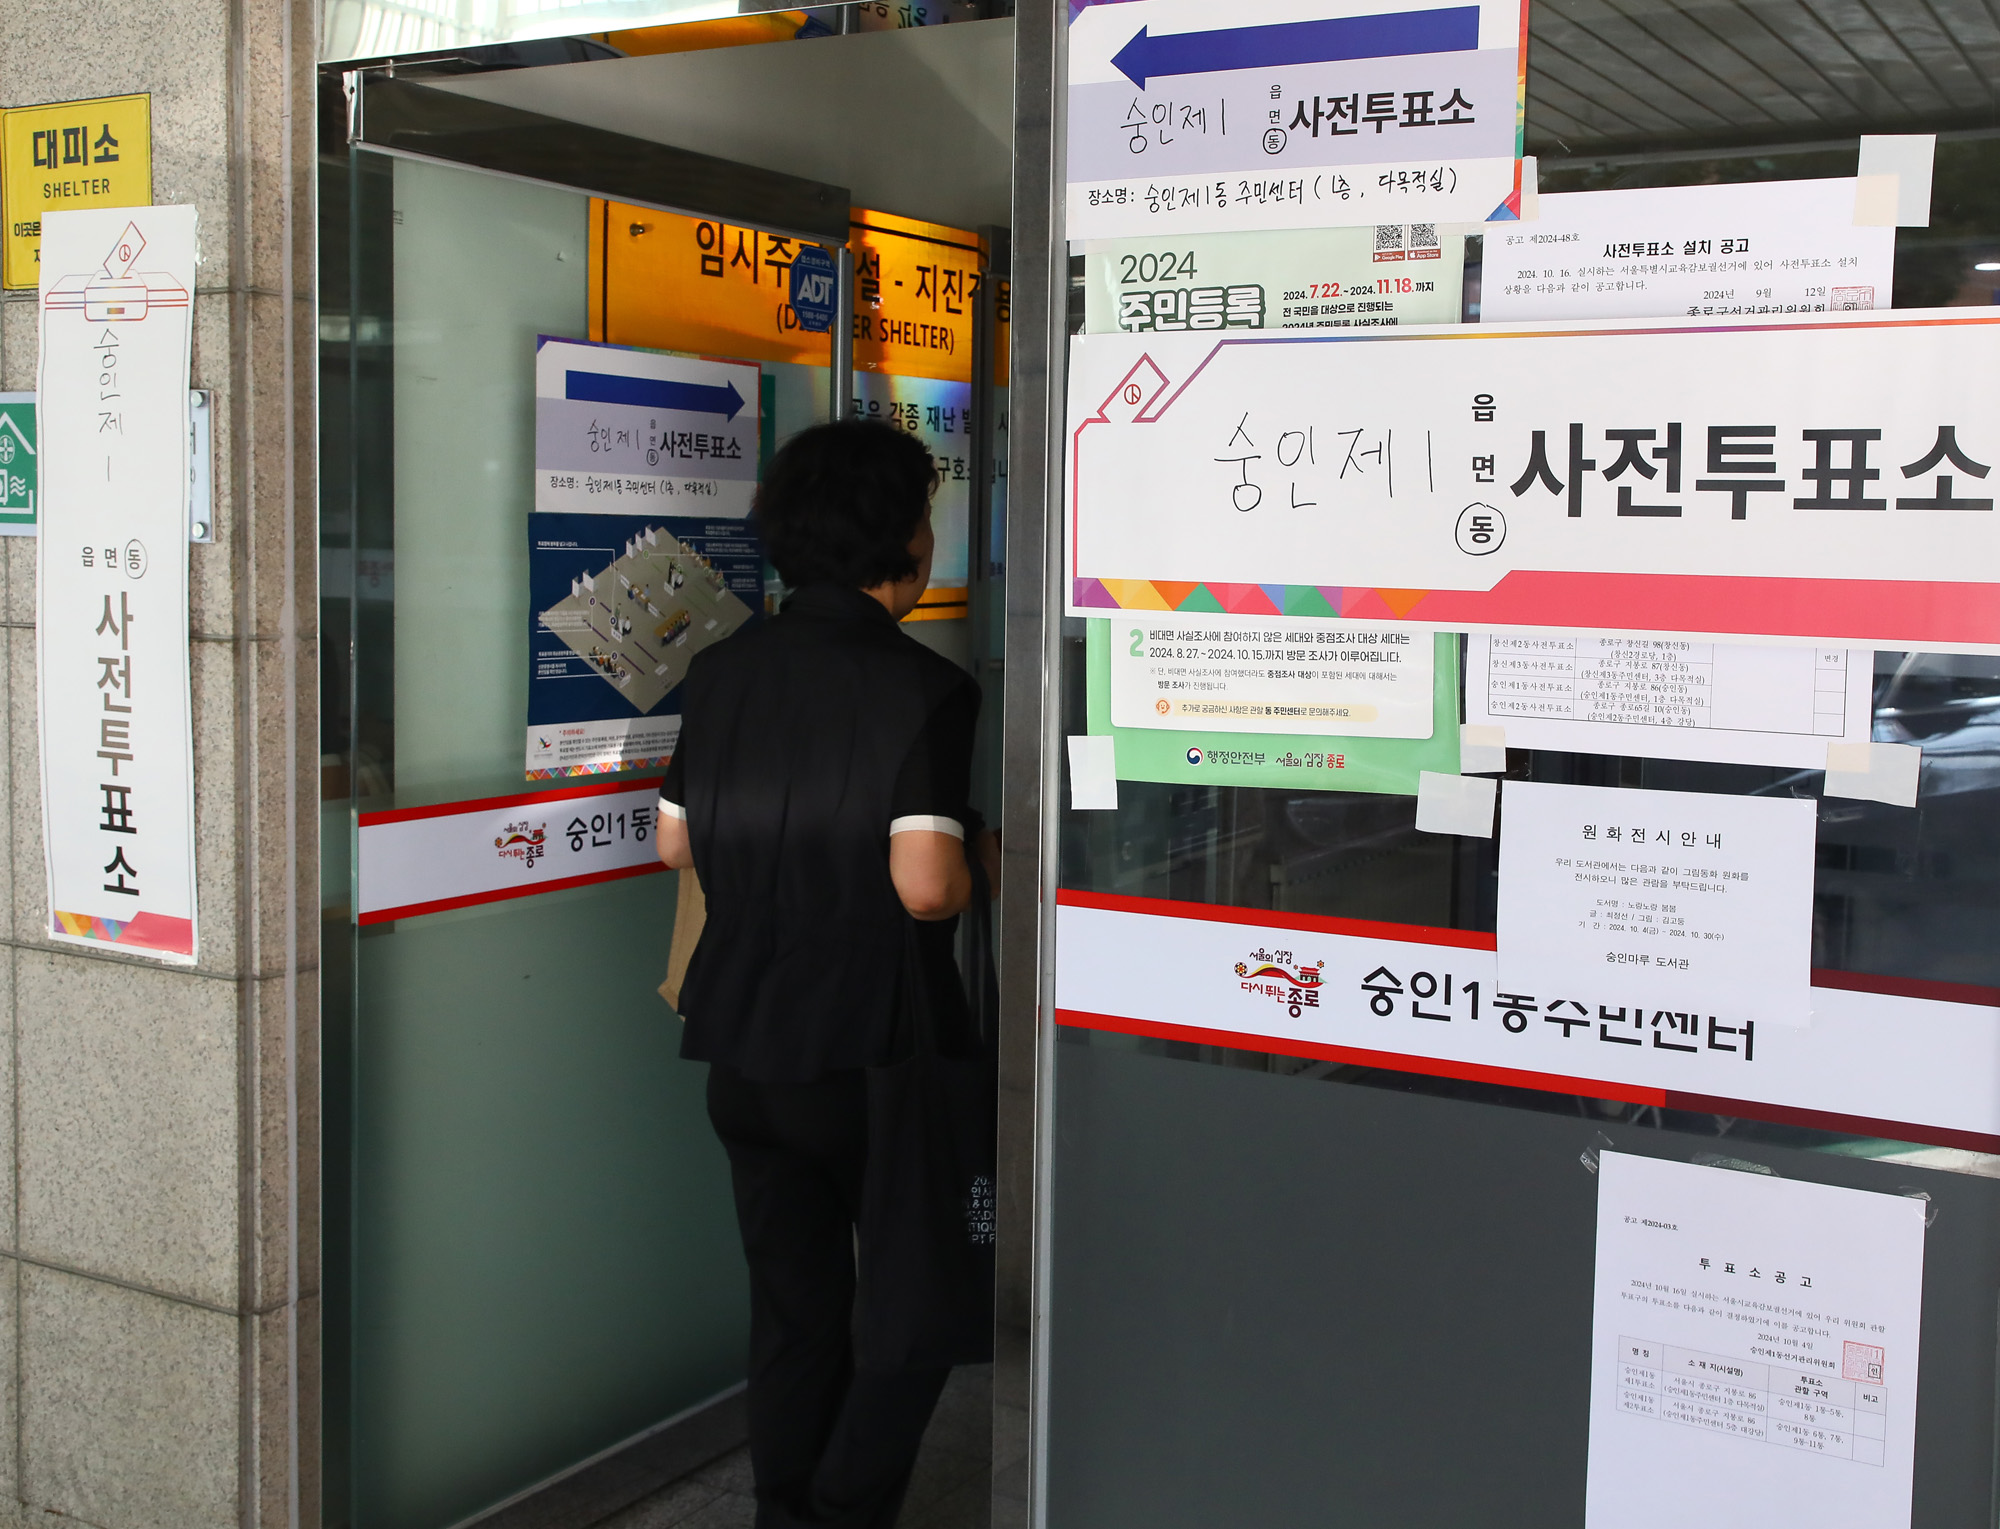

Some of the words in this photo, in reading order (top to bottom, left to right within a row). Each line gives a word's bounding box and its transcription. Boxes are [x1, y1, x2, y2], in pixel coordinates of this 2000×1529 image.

[1269, 84, 1282, 98] 읍
[1268, 110, 1281, 125] 면
[1288, 87, 1475, 138] 사전투표소
[33, 123, 119, 169] 대피소
[43, 178, 110, 199] SHELTER
[1088, 188, 1135, 207] 장소명:
[1235, 177, 1304, 206] 주민센터
[1505, 235, 1525, 246] 공고
[1528, 232, 1581, 244] 제2024-48호
[1602, 240, 1675, 259] 사전투표소
[1683, 239, 1712, 255] 설치
[1720, 238, 1749, 254] 공고
[1120, 251, 1198, 284] 2024
[1517, 270, 1538, 279] 2024.
[1542, 269, 1555, 278] 10.
[1559, 269, 1572, 278] 16.
[1577, 266, 1615, 277] 실시하는
[1754, 260, 1774, 271] 있어
[1779, 258, 1831, 270] 사전투표소
[1837, 257, 1858, 268] 설치
[797, 273, 834, 306] ADT
[1503, 285, 1532, 296] 상황을
[1536, 283, 1566, 294] 다음과
[1570, 282, 1590, 293] 같이
[1595, 280, 1648, 292] 공고합니다.
[1703, 289, 1735, 300] 2024년
[1756, 288, 1772, 299] 9월
[1805, 286, 1826, 297] 12일
[1119, 284, 1266, 333] 주민등록
[1282, 307, 1292, 318] 전
[1293, 305, 1319, 317] 국민을
[1320, 303, 1356, 315] 대상으로
[1357, 301, 1394, 313] 진행되는
[926, 405, 956, 433] 재난
[1471, 393, 1497, 422] 읍
[660, 430, 742, 460] 사전투표소
[1472, 455, 1497, 483] 면
[1508, 421, 1994, 520] 사전투표소
[1468, 514, 1496, 545] 동
[82, 546, 95, 568] 읍
[1129, 628, 1144, 657] 2
[1149, 630, 1175, 642] 비대면
[1176, 630, 1221, 642] 사실조사에
[1223, 631, 1261, 643] 참여하지
[1263, 632, 1283, 643] 않은
[1285, 632, 1314, 643] 세대와
[1316, 633, 1356, 644] 중점조사
[1357, 633, 1378, 645] 대상
[1380, 634, 1410, 645] 세대는
[1286, 651, 1306, 662] 방문
[1308, 651, 1338, 662] 조사가
[1340, 652, 1402, 663] 이루어집니다.
[1157, 680, 1171, 689] 방문
[1172, 681, 1192, 690] 조사가
[1167, 668, 1187, 677] 비대면
[1188, 668, 1222, 677] 사실조사에
[1267, 670, 1296, 679] 중점조사
[1297, 671, 1319, 680] 대상이
[1321, 671, 1343, 680] 포함된
[1344, 672, 1367, 681] 세대에
[1368, 672, 1398, 682] 대해서는
[1273, 707, 1308, 716] 주민센터로
[94, 590, 140, 897] 사전투표소
[1206, 749, 1266, 766] 행정안전부
[1276, 752, 1302, 768] 서울의
[1304, 752, 1324, 768] 심장
[1326, 754, 1345, 769] 종로
[566, 806, 659, 852] 숭인1동
[526, 845, 544, 869] 종로
[1555, 858, 1572, 868] 우리
[1575, 859, 1627, 872] 도서관에서는
[1630, 863, 1656, 874] 다음과
[1661, 865, 1678, 876] 같이
[1682, 867, 1718, 879] 그림동화
[1722, 871, 1750, 882] 원화를
[1574, 872, 1617, 885] 전시하오니
[1620, 875, 1638, 886] 많은
[1642, 878, 1668, 889] 관람을
[1672, 880, 1728, 894] 부탁드립니다.
[1249, 947, 1273, 962] 서울의
[1274, 950, 1292, 965] 심장
[1606, 951, 1650, 966] 숭인마루
[1656, 956, 1690, 970] 도서관
[1241, 982, 1263, 995] 다시
[1265, 985, 1285, 1003] 뛰는
[1287, 987, 1320, 1018] 종로
